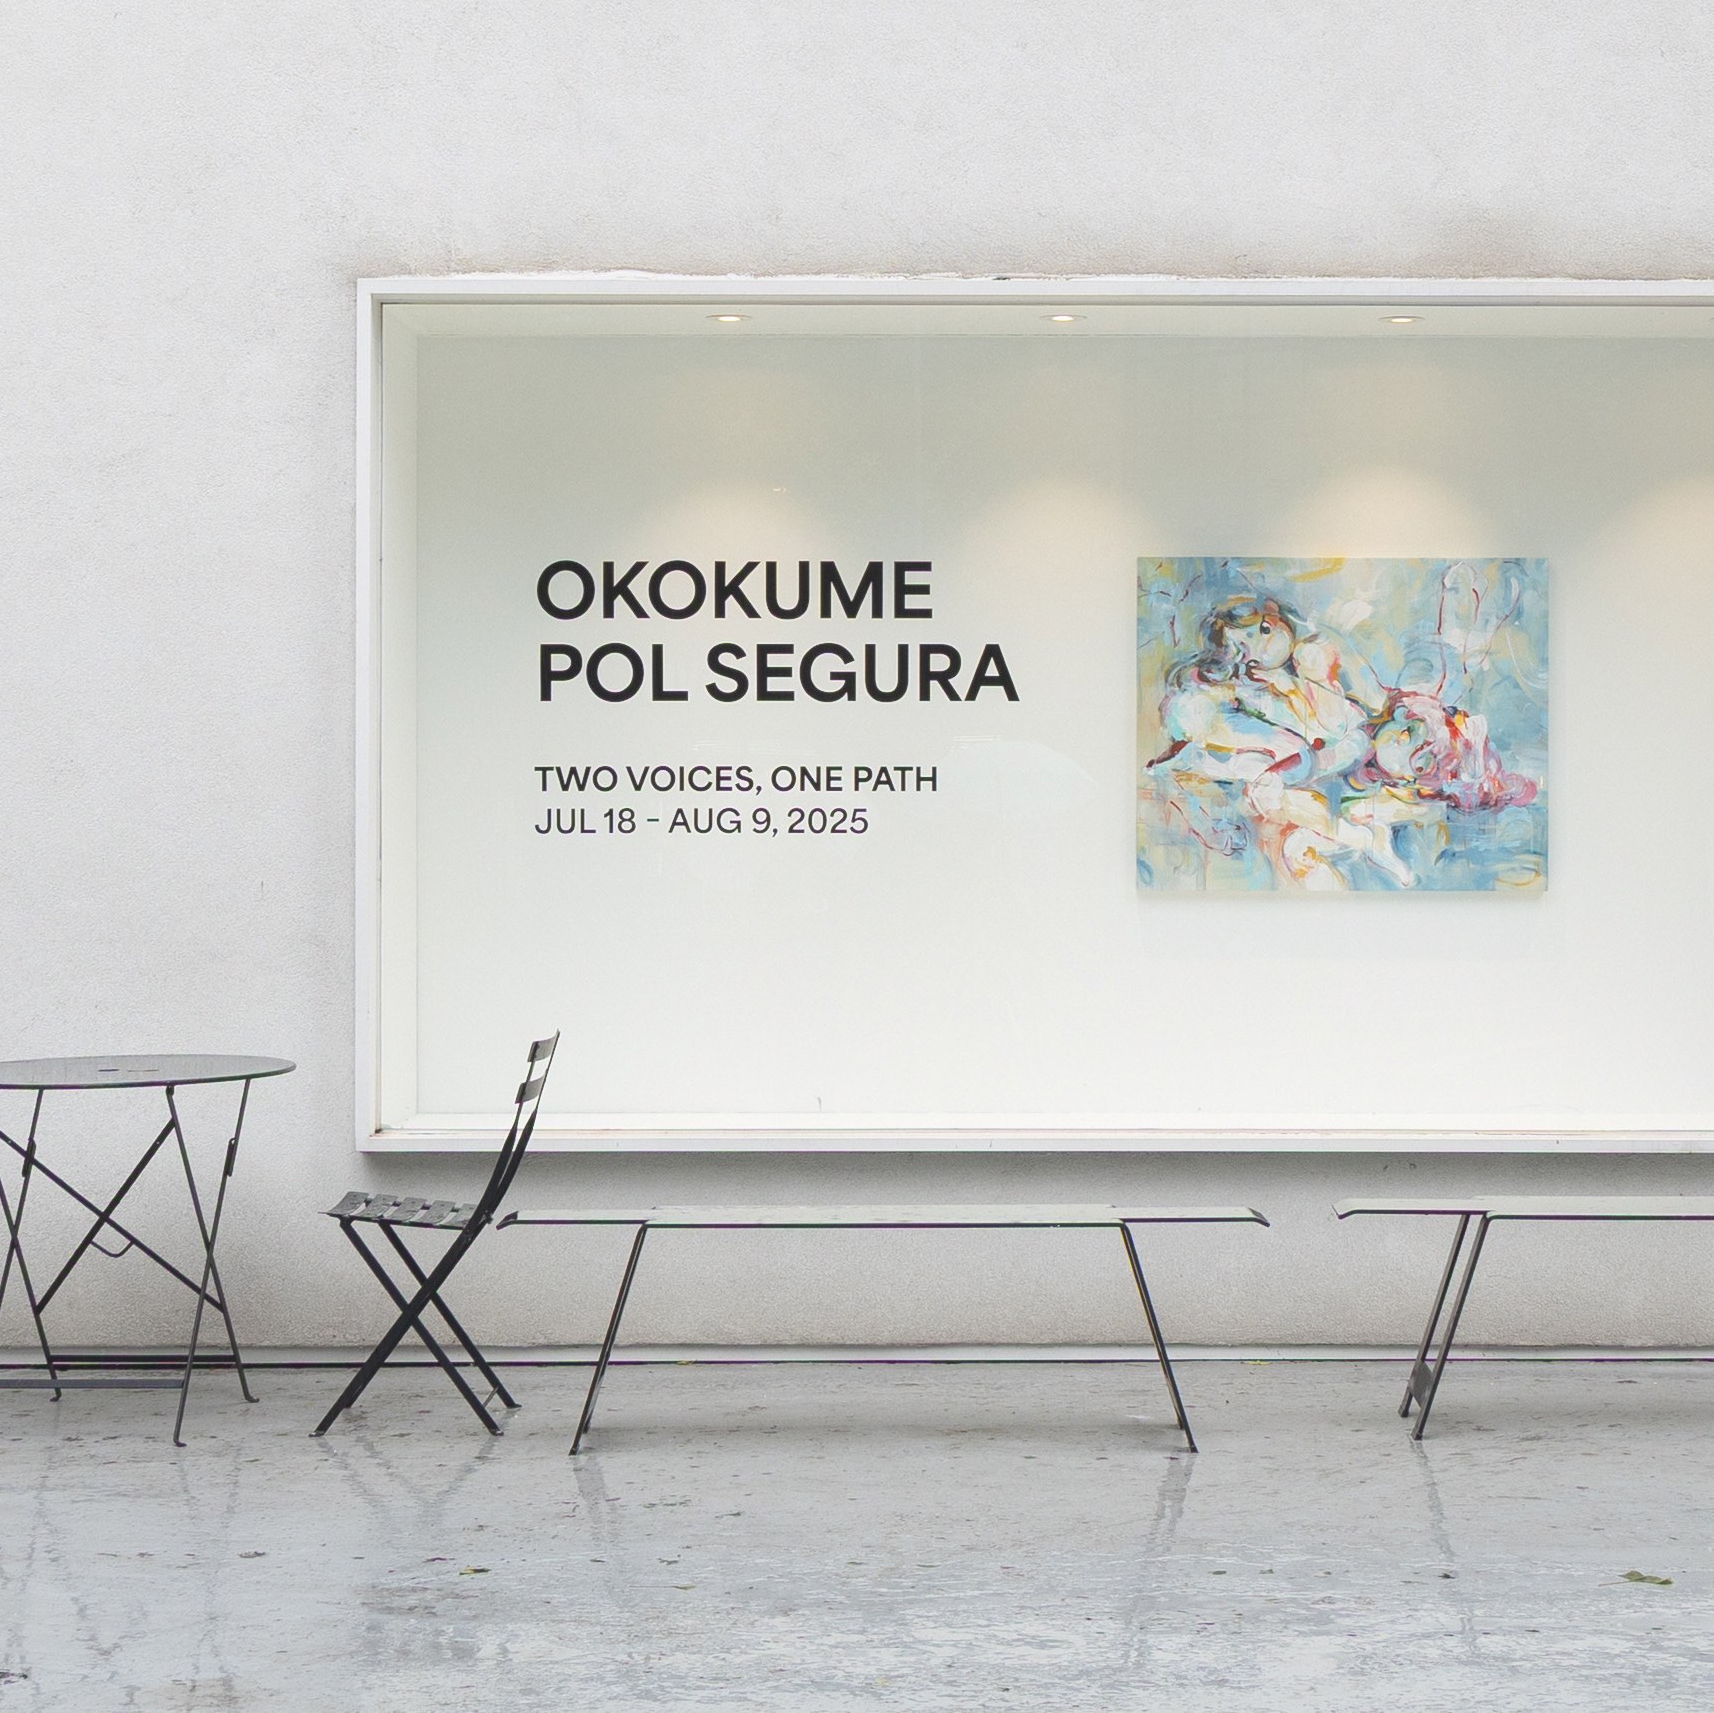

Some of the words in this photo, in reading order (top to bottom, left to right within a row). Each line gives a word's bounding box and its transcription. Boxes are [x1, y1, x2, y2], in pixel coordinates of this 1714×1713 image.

[536, 559, 933, 621] OKOKUME
[539, 642, 689, 703] POL
[705, 642, 1021, 703] SEGURA
[534, 765, 618, 793] TWO
[627, 765, 763, 797] VOICES,
[771, 765, 843, 793] ONE
[853, 765, 938, 793] PATH
[534, 807, 597, 835] JUL
[603, 807, 637, 835] 18
[668, 807, 742, 835] AUG
[752, 807, 779, 838] 9,
[787, 807, 870, 835] 2025
